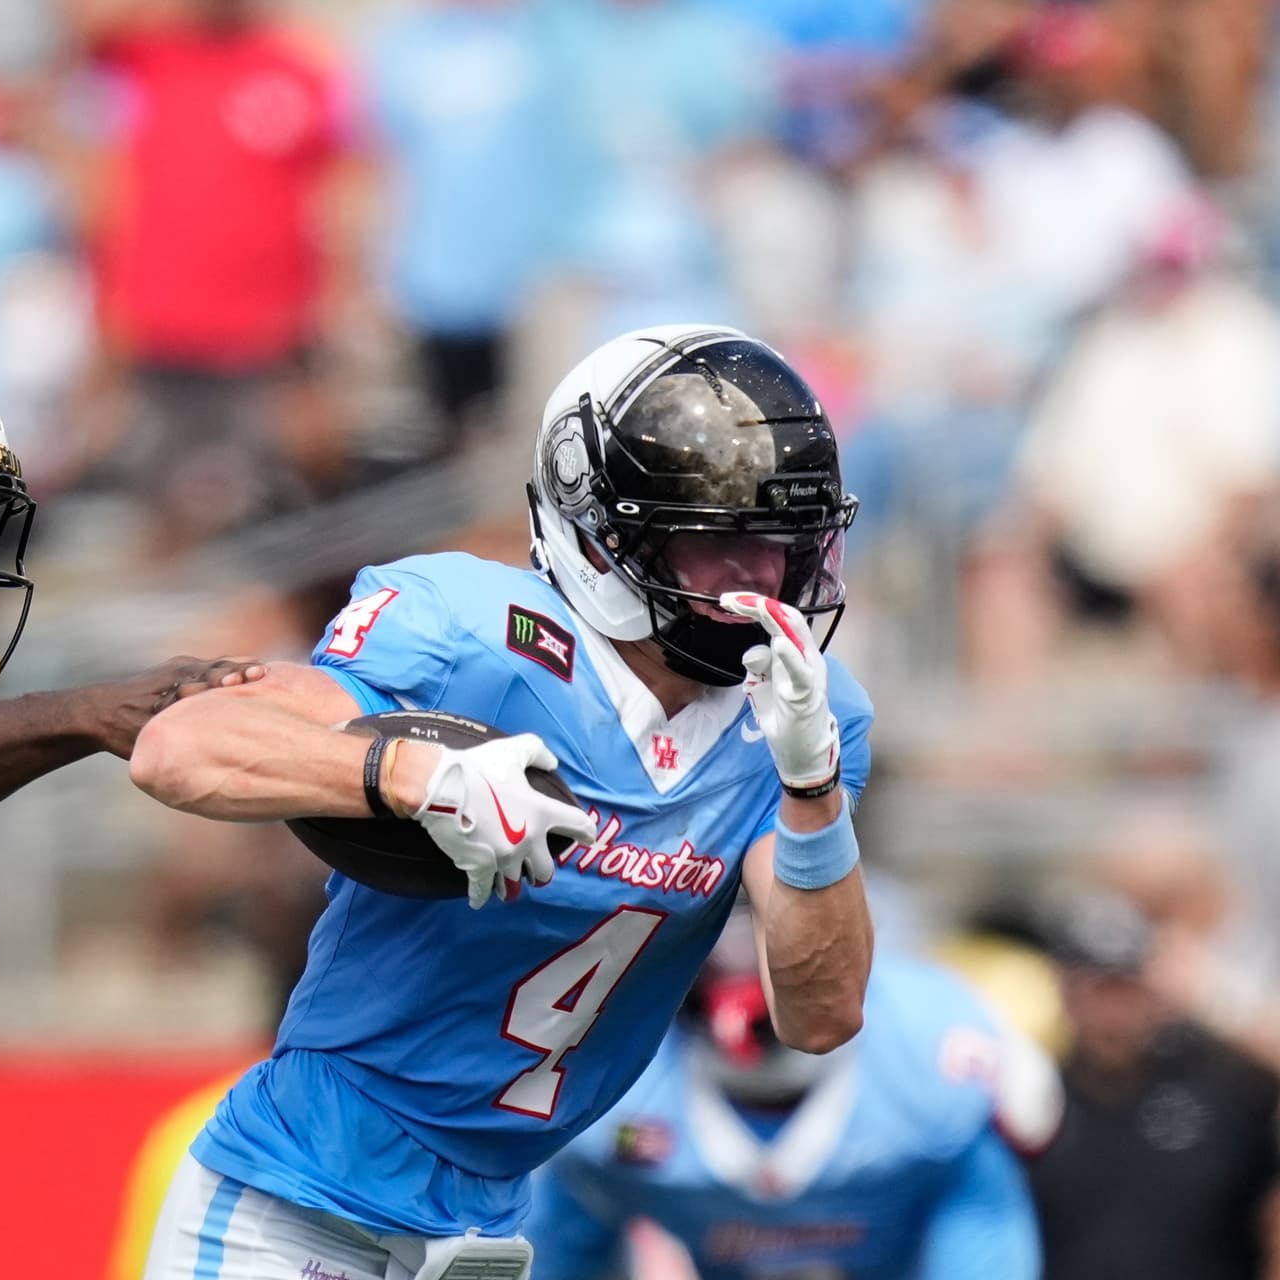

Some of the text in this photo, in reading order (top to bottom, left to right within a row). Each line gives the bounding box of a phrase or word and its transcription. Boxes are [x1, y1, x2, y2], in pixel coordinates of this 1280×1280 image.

[325, 587, 400, 659] 4
[558, 806, 725, 898] Houston
[494, 904, 669, 1122] 4
